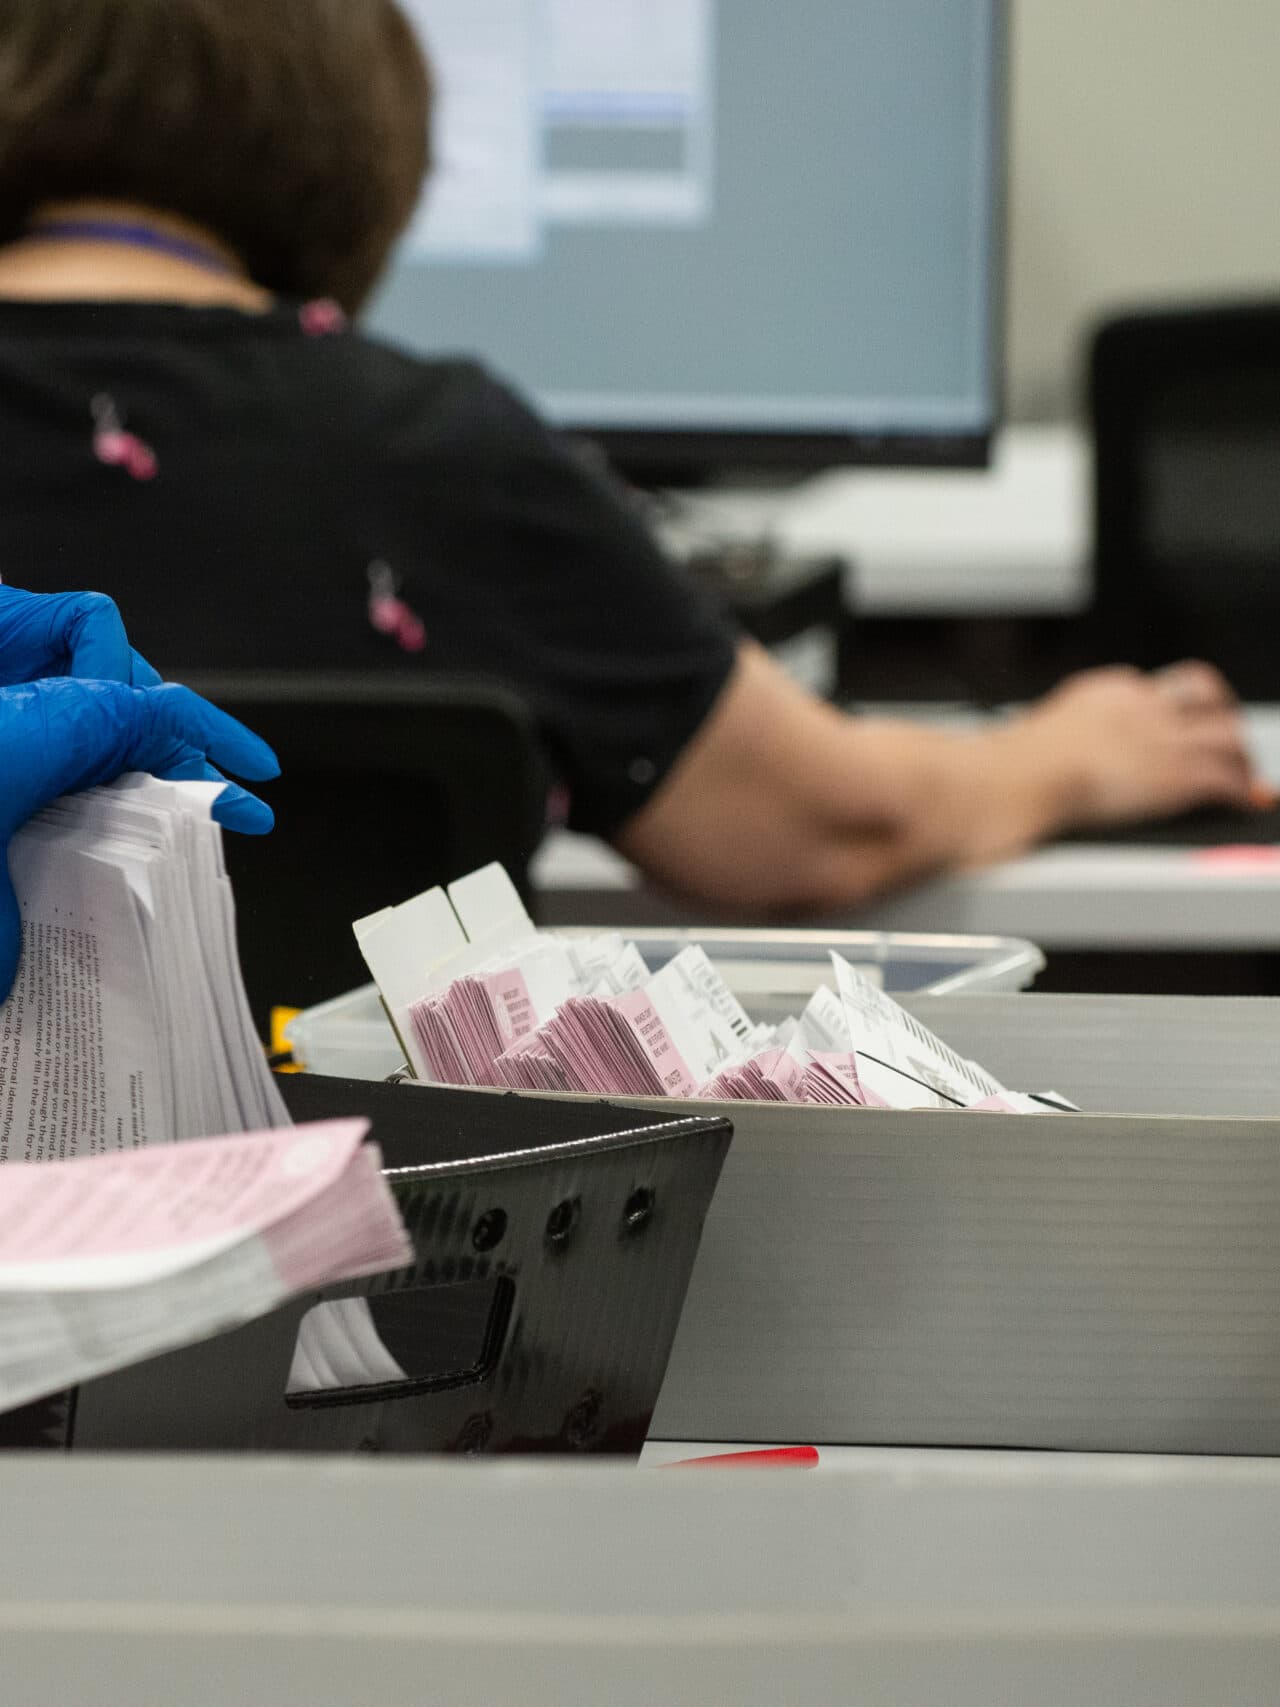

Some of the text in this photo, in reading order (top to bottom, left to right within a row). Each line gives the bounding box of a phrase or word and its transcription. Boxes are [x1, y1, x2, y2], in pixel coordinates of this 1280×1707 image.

[77, 951, 85, 975] right
[70, 961, 78, 988] mark
[28, 989, 36, 1005] for.
[45, 983, 53, 1016] simply
[79, 992, 87, 1017] each
[5, 1005, 13, 1023] you
[2, 1026, 13, 1042] do,
[13, 1017, 22, 1036] any
[33, 998, 43, 1057] completely
[45, 1019, 53, 1046] draw
[0, 1046, 9, 1063] the
[9, 1038, 20, 1084] personal
[33, 1059, 41, 1073] fill
[43, 1058, 52, 1077] line
[52, 1056, 61, 1094] change
[32, 1075, 40, 1085] in
[30, 1088, 38, 1105] the
[38, 1080, 50, 1122] through
[0, 1087, 16, 1142] identifying
[27, 1108, 35, 1130] oval
[70, 1091, 78, 1143] permitted
[89, 1108, 97, 1136] filling
[37, 1125, 46, 1142] the
[48, 1123, 57, 1151] mind
[60, 1116, 69, 1137] that
[25, 1133, 34, 1148] for
[69, 1146, 77, 1156] in
[0, 1145, 9, 1165] info
